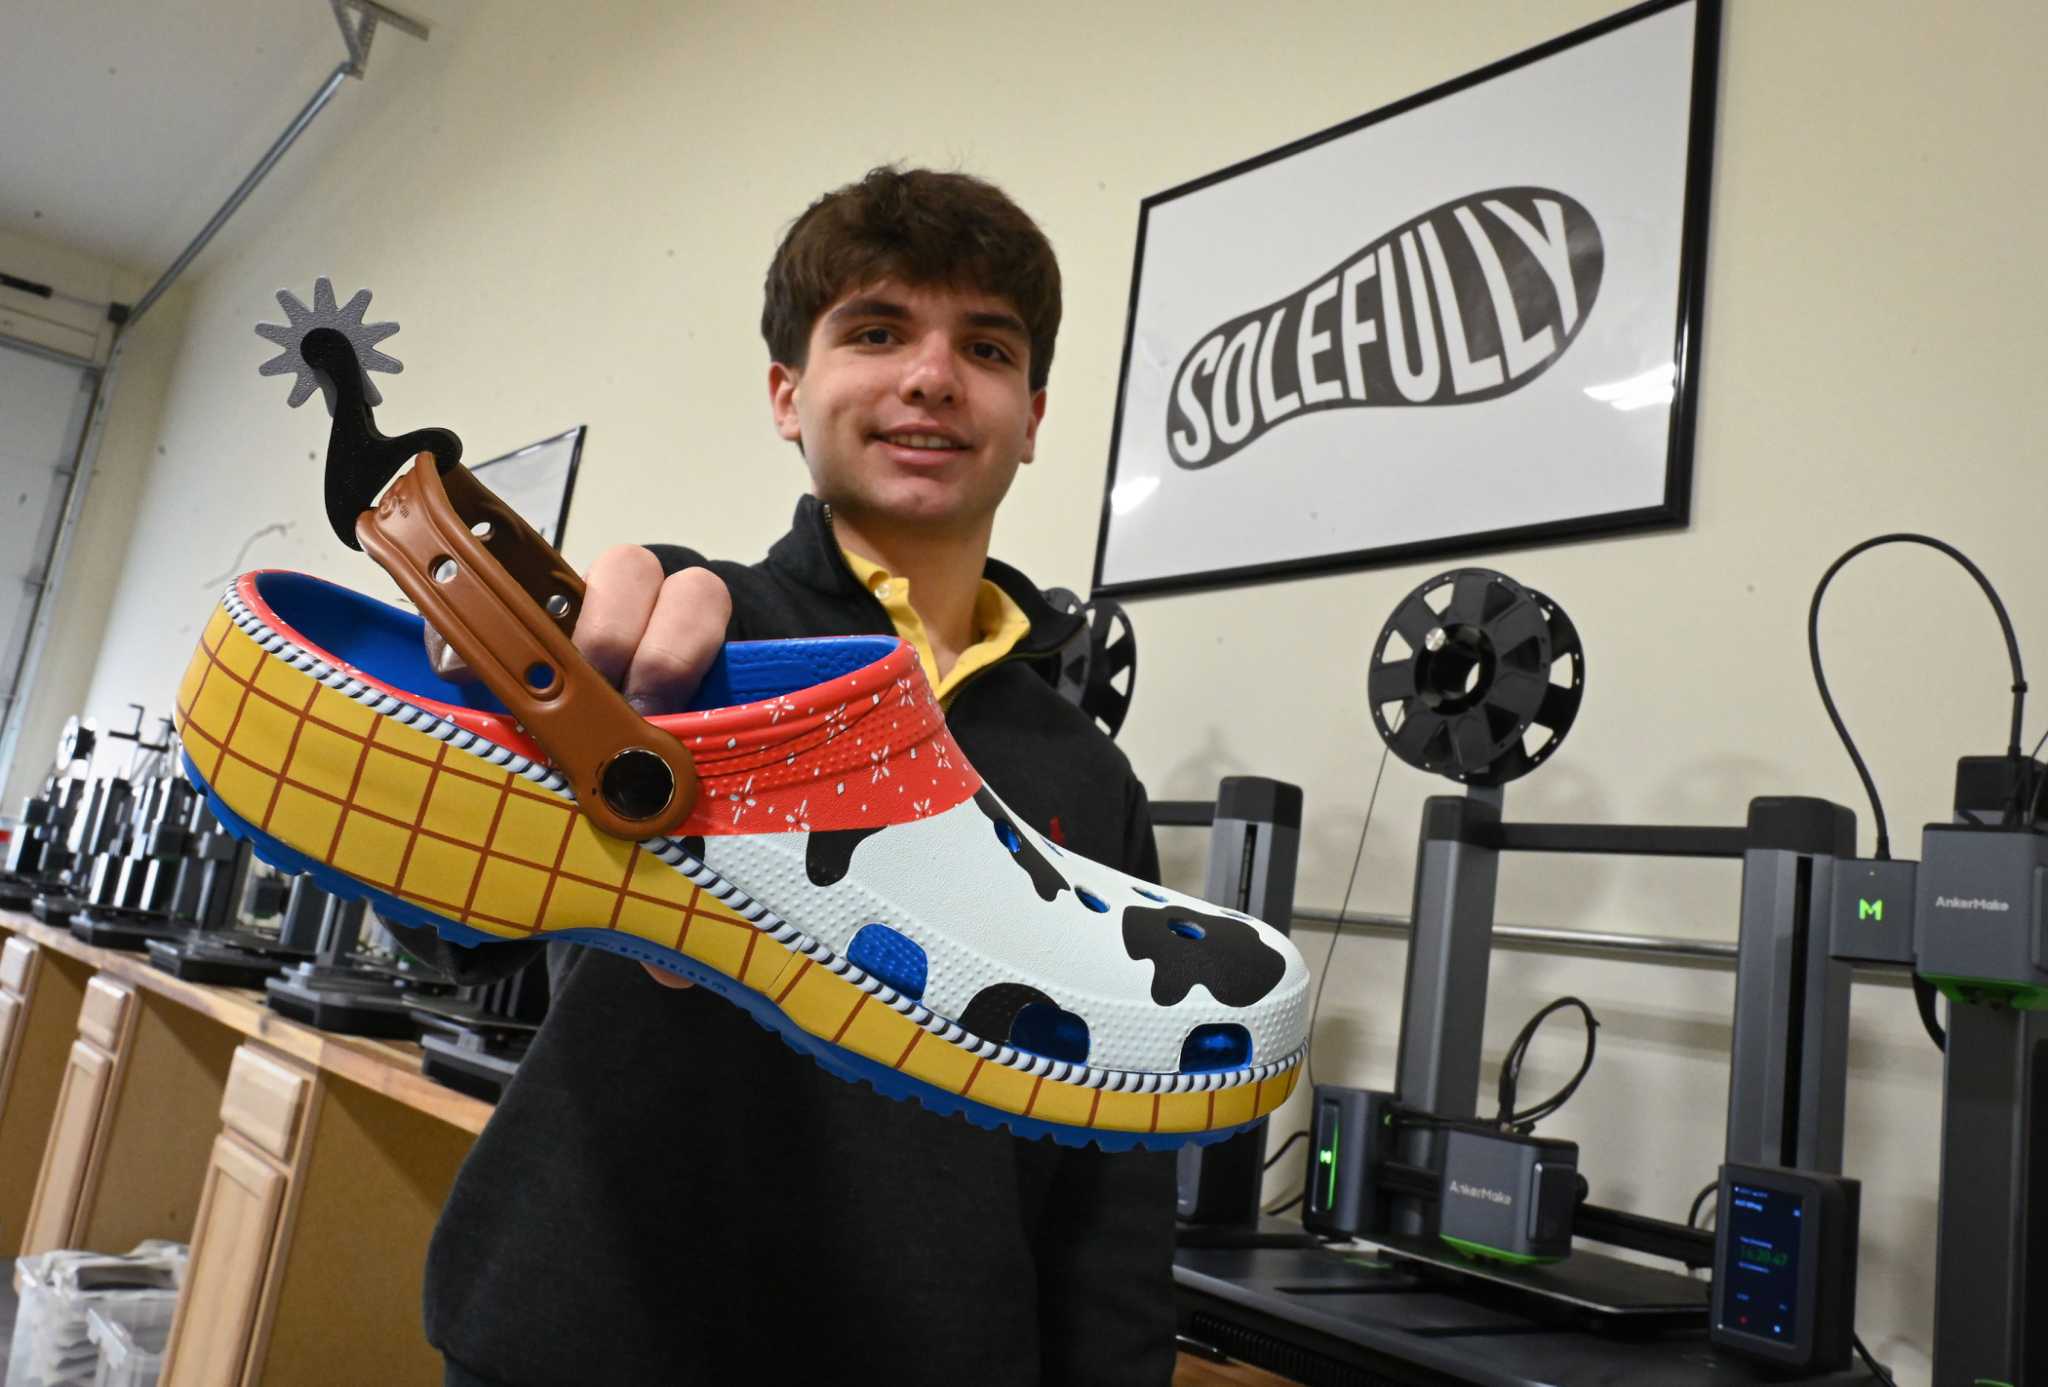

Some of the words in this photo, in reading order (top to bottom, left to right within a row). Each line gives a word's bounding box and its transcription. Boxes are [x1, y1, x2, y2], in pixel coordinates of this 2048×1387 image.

[1172, 198, 1579, 463] SOLEFULLY
[1859, 898, 1884, 921] M
[1935, 895, 2010, 912] AnkerMake
